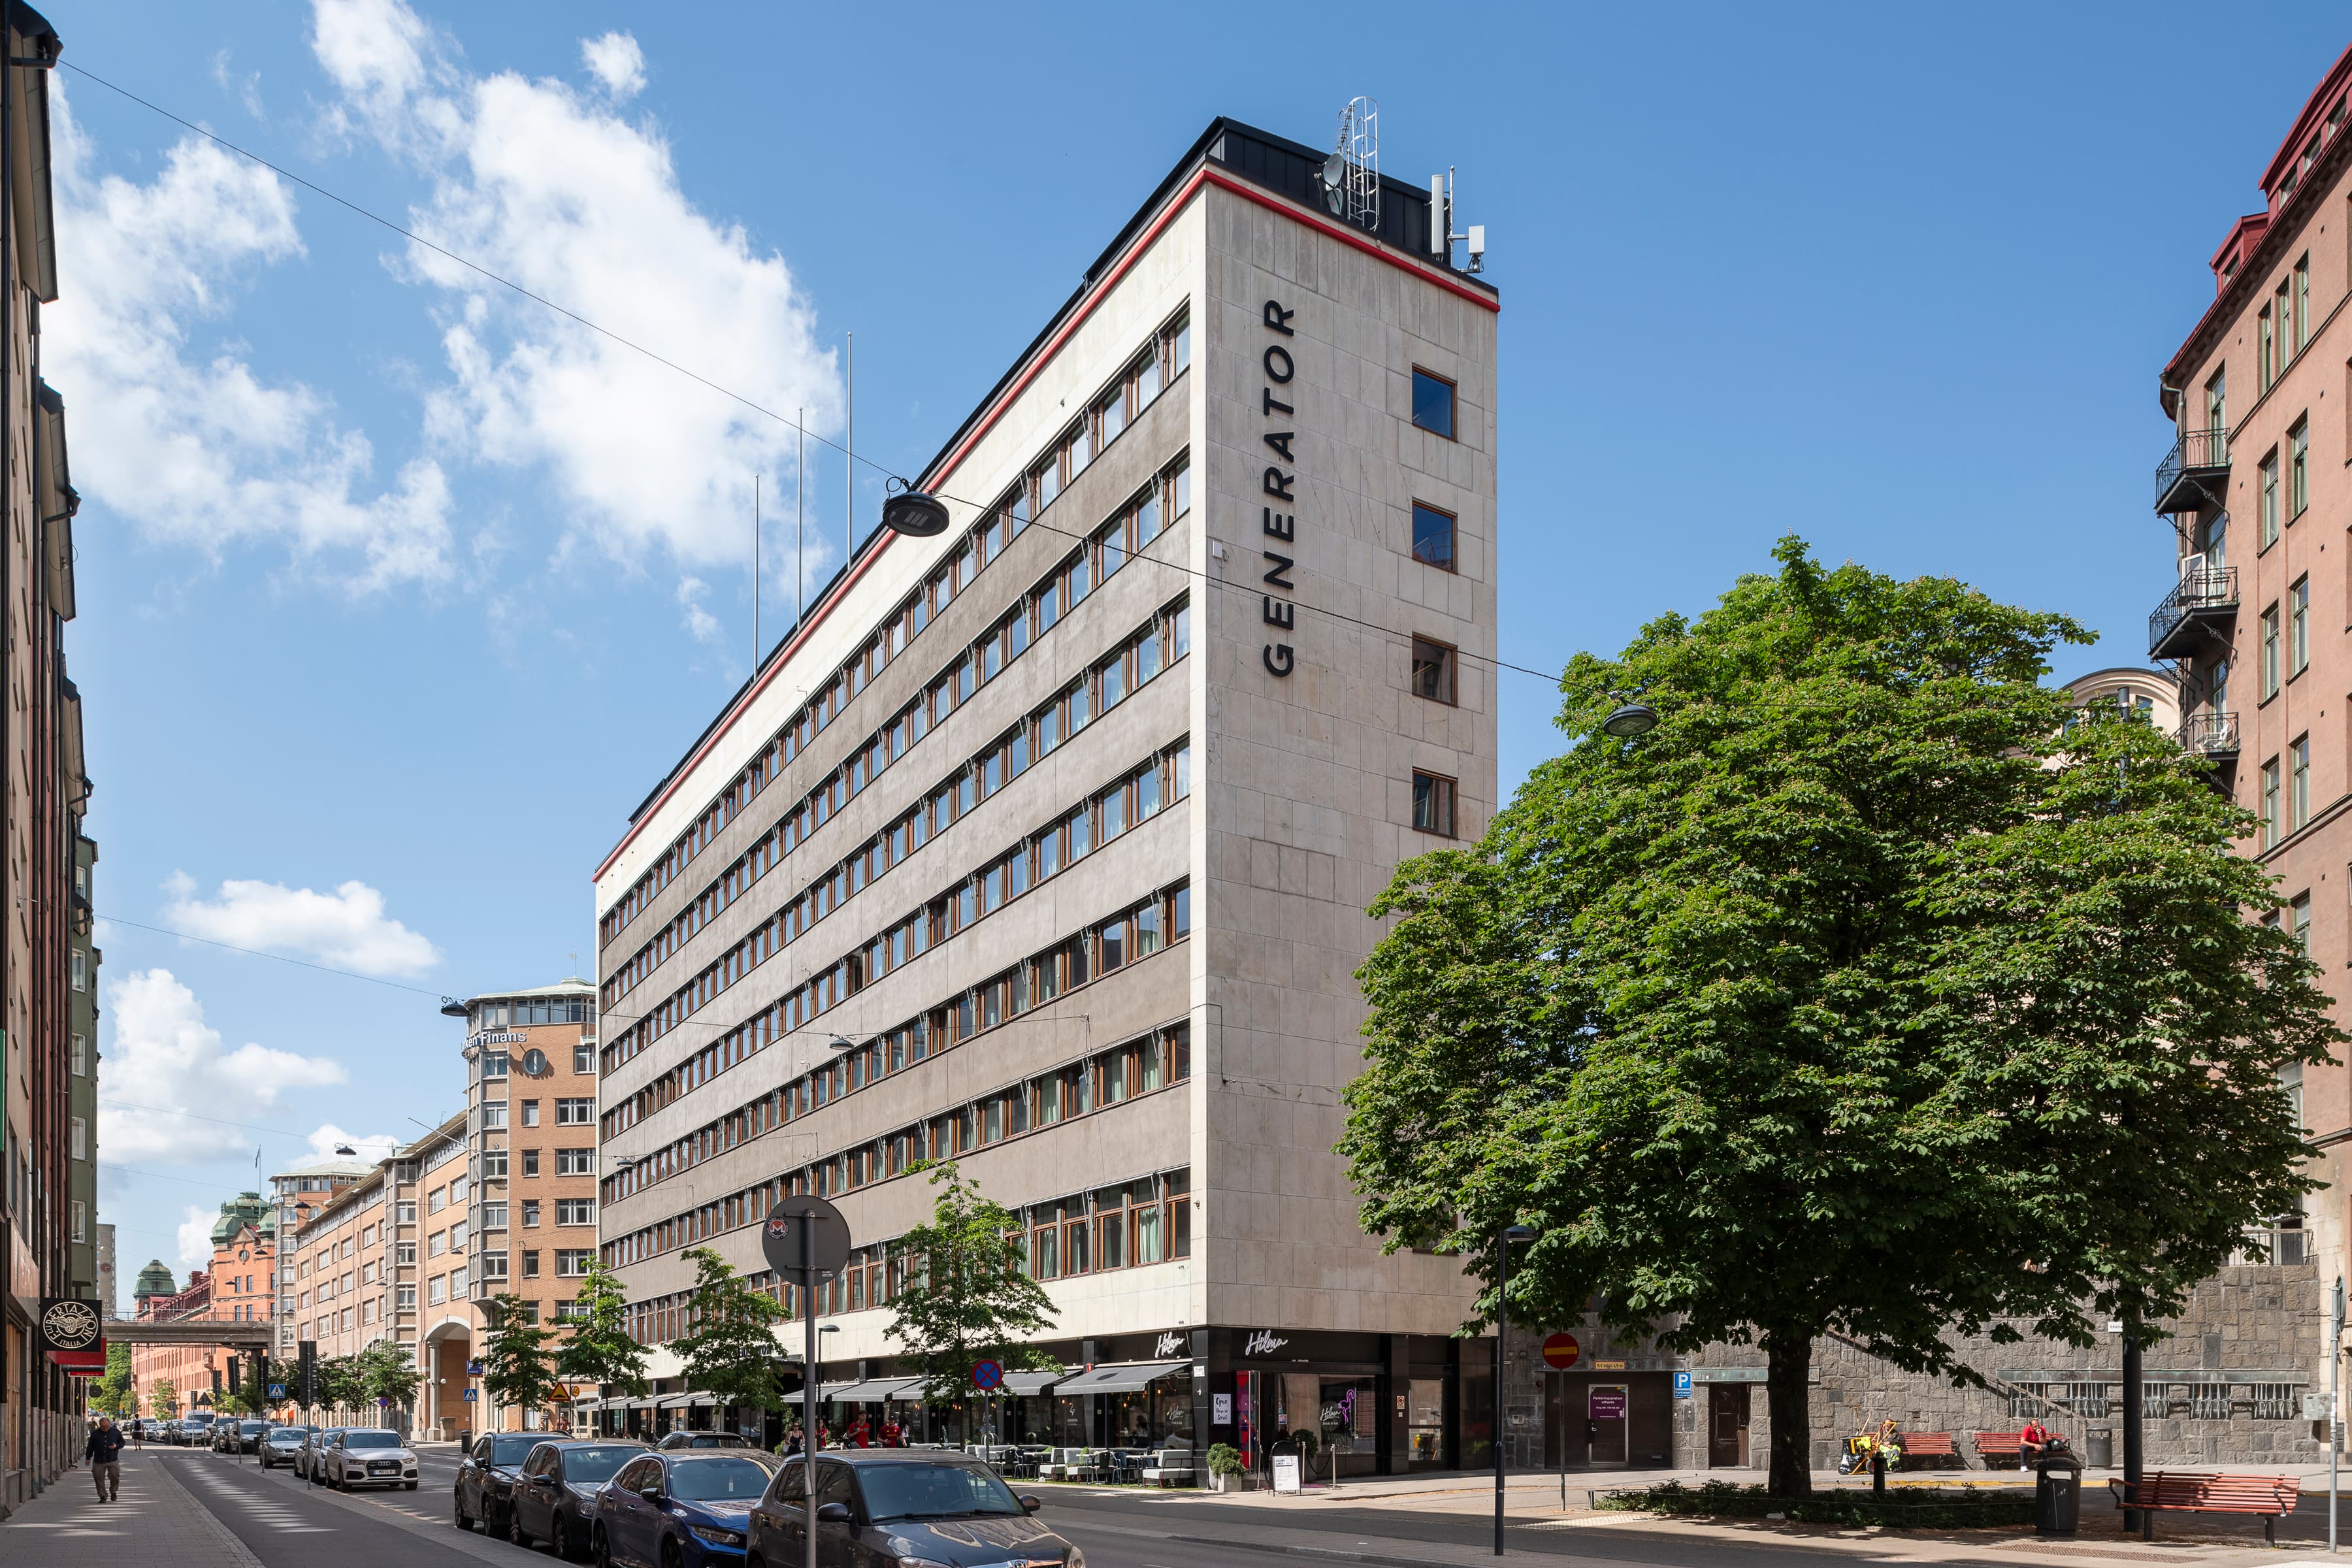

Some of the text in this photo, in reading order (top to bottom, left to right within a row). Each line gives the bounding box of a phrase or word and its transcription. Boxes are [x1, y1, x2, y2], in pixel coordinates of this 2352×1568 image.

[1264, 299, 1294, 678] GENERATOR
[481, 1031, 527, 1045] Finans
[46, 1303, 96, 1341] BERTAZZONI
[1245, 1330, 1288, 1356] Hilma
[1678, 1374, 1688, 1388] P
[1320, 1406, 1341, 1421] Hilma
